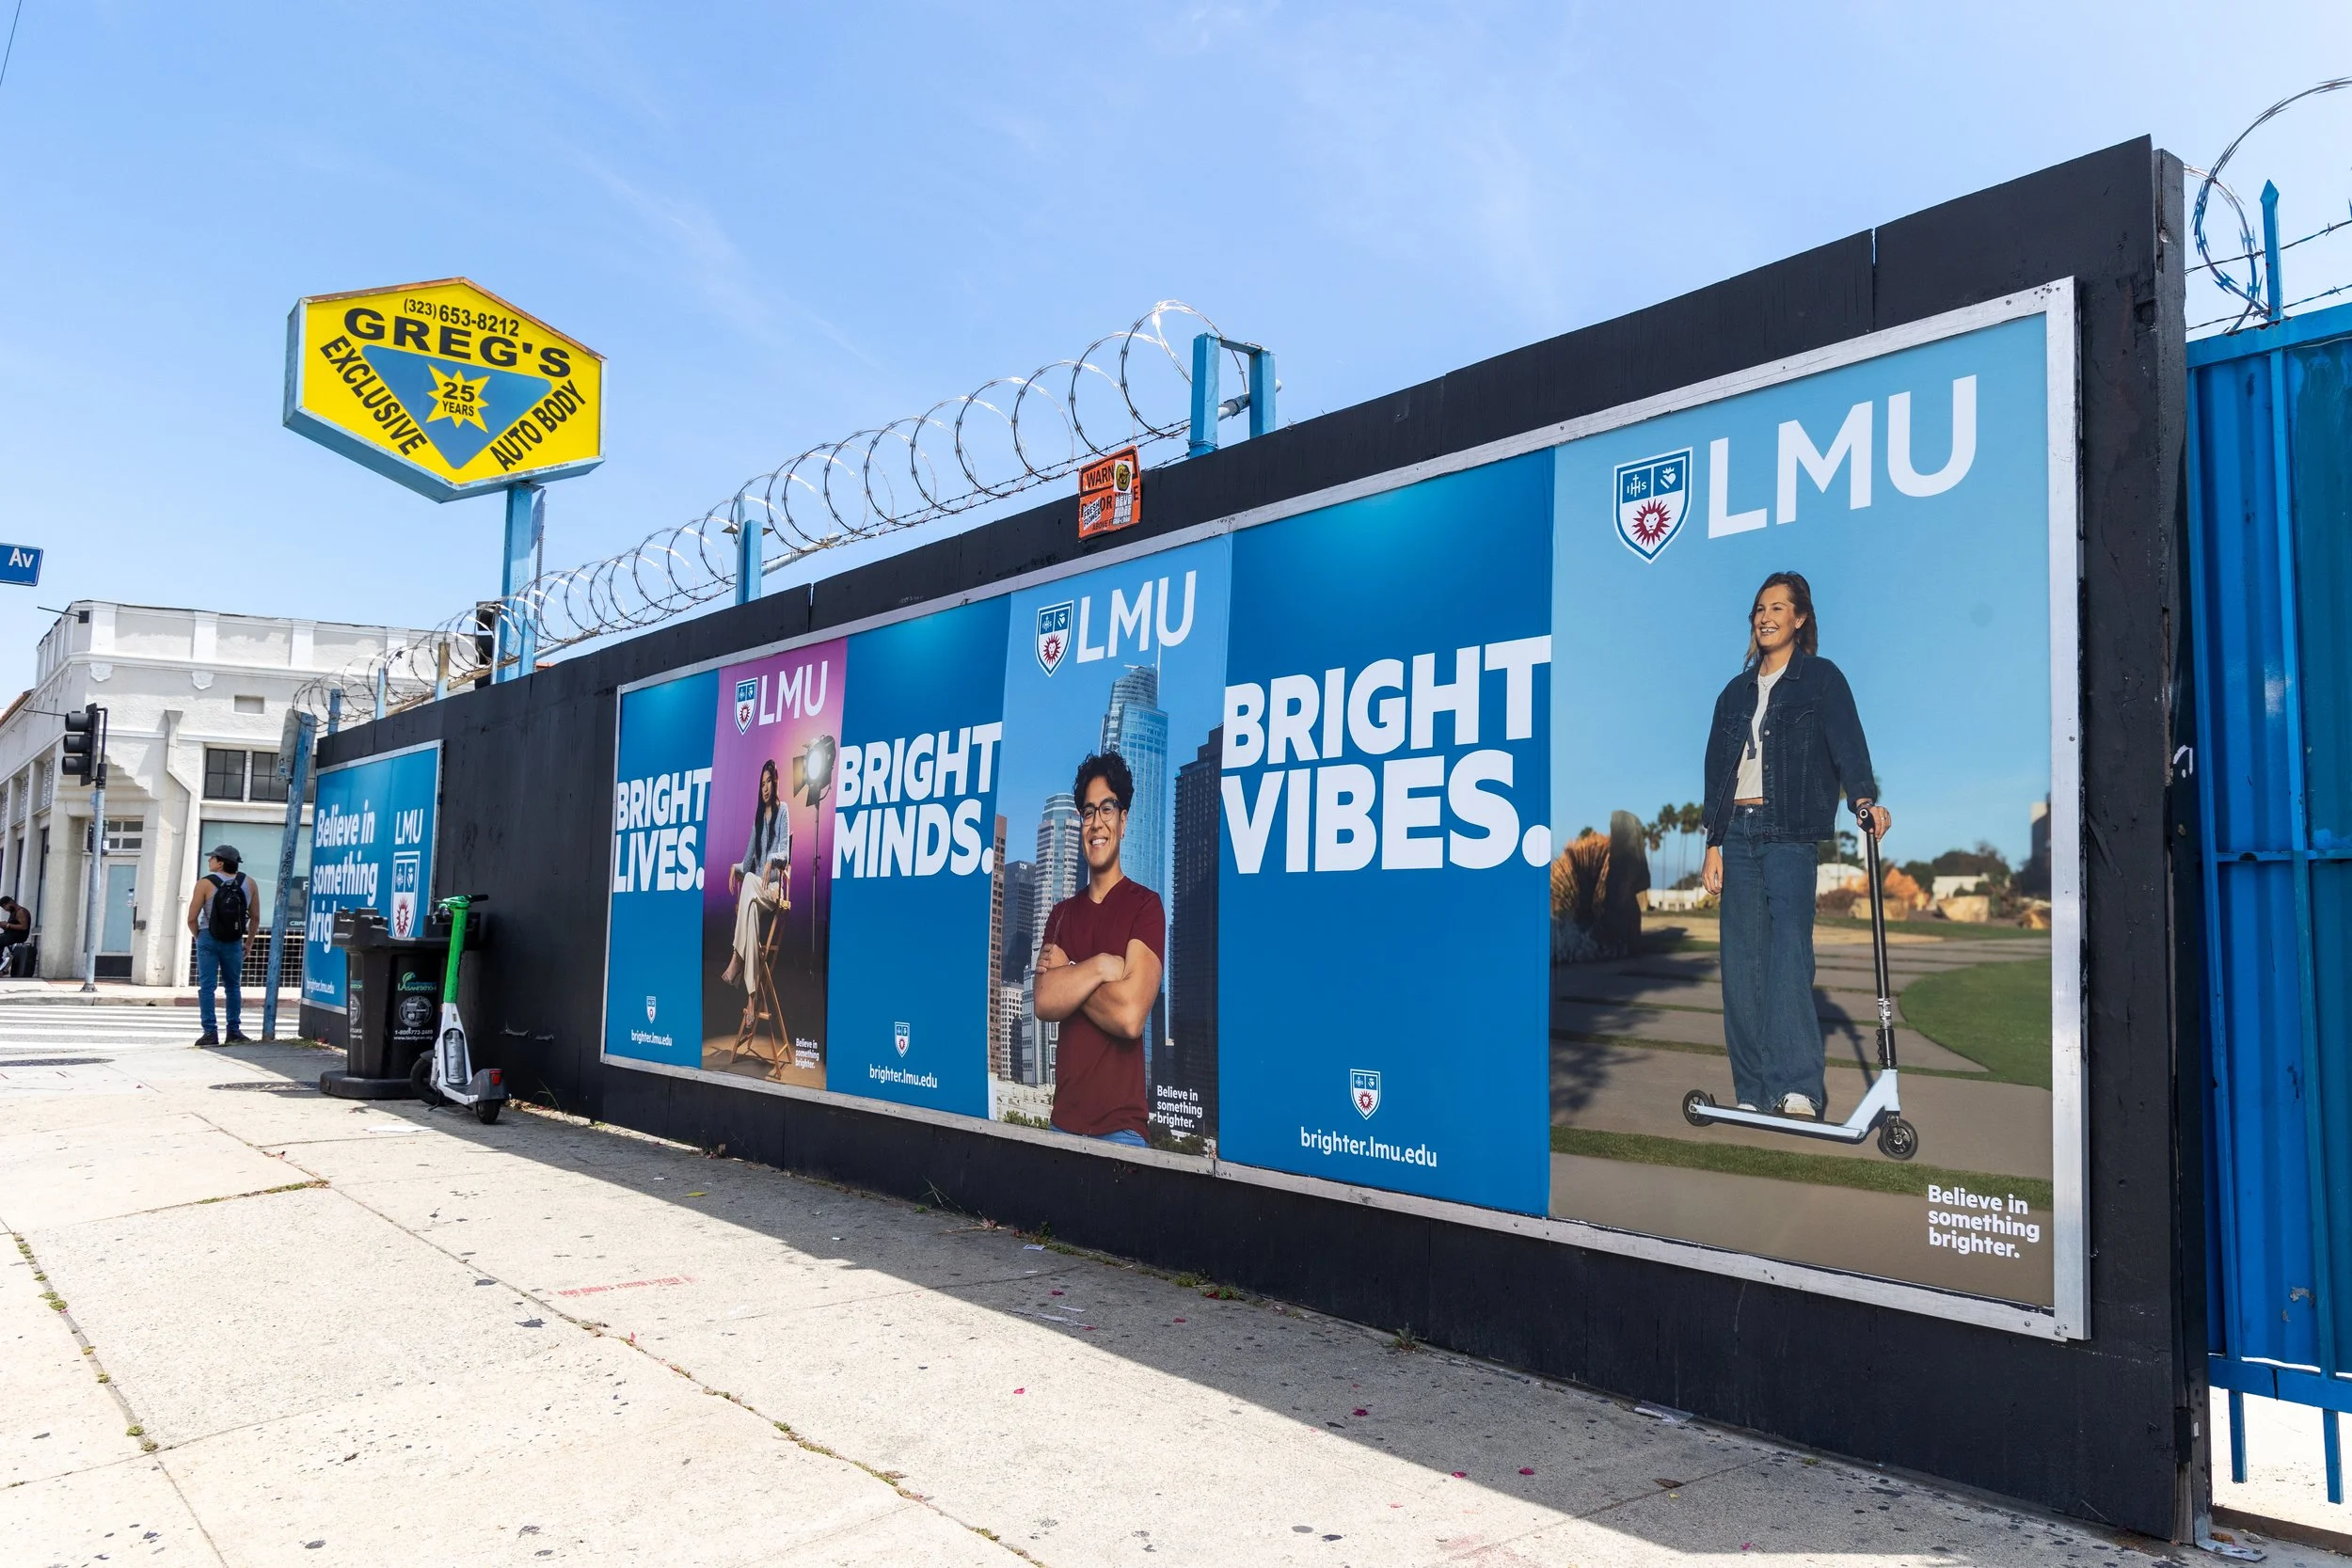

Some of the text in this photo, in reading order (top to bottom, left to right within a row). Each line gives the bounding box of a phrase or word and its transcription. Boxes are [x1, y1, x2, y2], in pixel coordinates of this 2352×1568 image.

[404, 298, 520, 337] (323) 653-8212
[343, 308, 571, 378] GREG'S
[320, 335, 428, 457] EXCLUSIVE
[442, 381, 475, 403] 25
[442, 401, 475, 418] YEARS
[489, 379, 586, 471] AUTO BODY
[1708, 374, 1977, 539] LMU
[8, 547, 34, 568] Av
[1076, 570, 1197, 664] LMU
[758, 660, 828, 726] LMU
[1222, 634, 1552, 769] BRIGHT
[835, 721, 1002, 808] BRIGHT
[616, 767, 713, 832] BRIGHT
[1220, 750, 1552, 875] VIBES.
[315, 800, 376, 848] Believe in
[395, 808, 423, 845] LMU
[832, 798, 993, 879] MINDS.
[312, 850, 379, 907] something
[612, 825, 705, 893] LIVES.
[630, 1029, 673, 1046] brighter.lmu.edu
[795, 1037, 818, 1049] Believe in
[795, 1049, 819, 1062] something
[795, 1056, 816, 1069] brighter.
[869, 1063, 938, 1088] brighter.lmu.edu
[1156, 1085, 1199, 1101] Believe in
[1156, 1101, 1203, 1118] something
[1157, 1111, 1195, 1129] brighter.
[1300, 1126, 1438, 1167] brighter.lmu.edu
[1928, 1184, 2028, 1215] Believe in
[1928, 1210, 2040, 1243] something
[1929, 1227, 2021, 1259] brighter.
